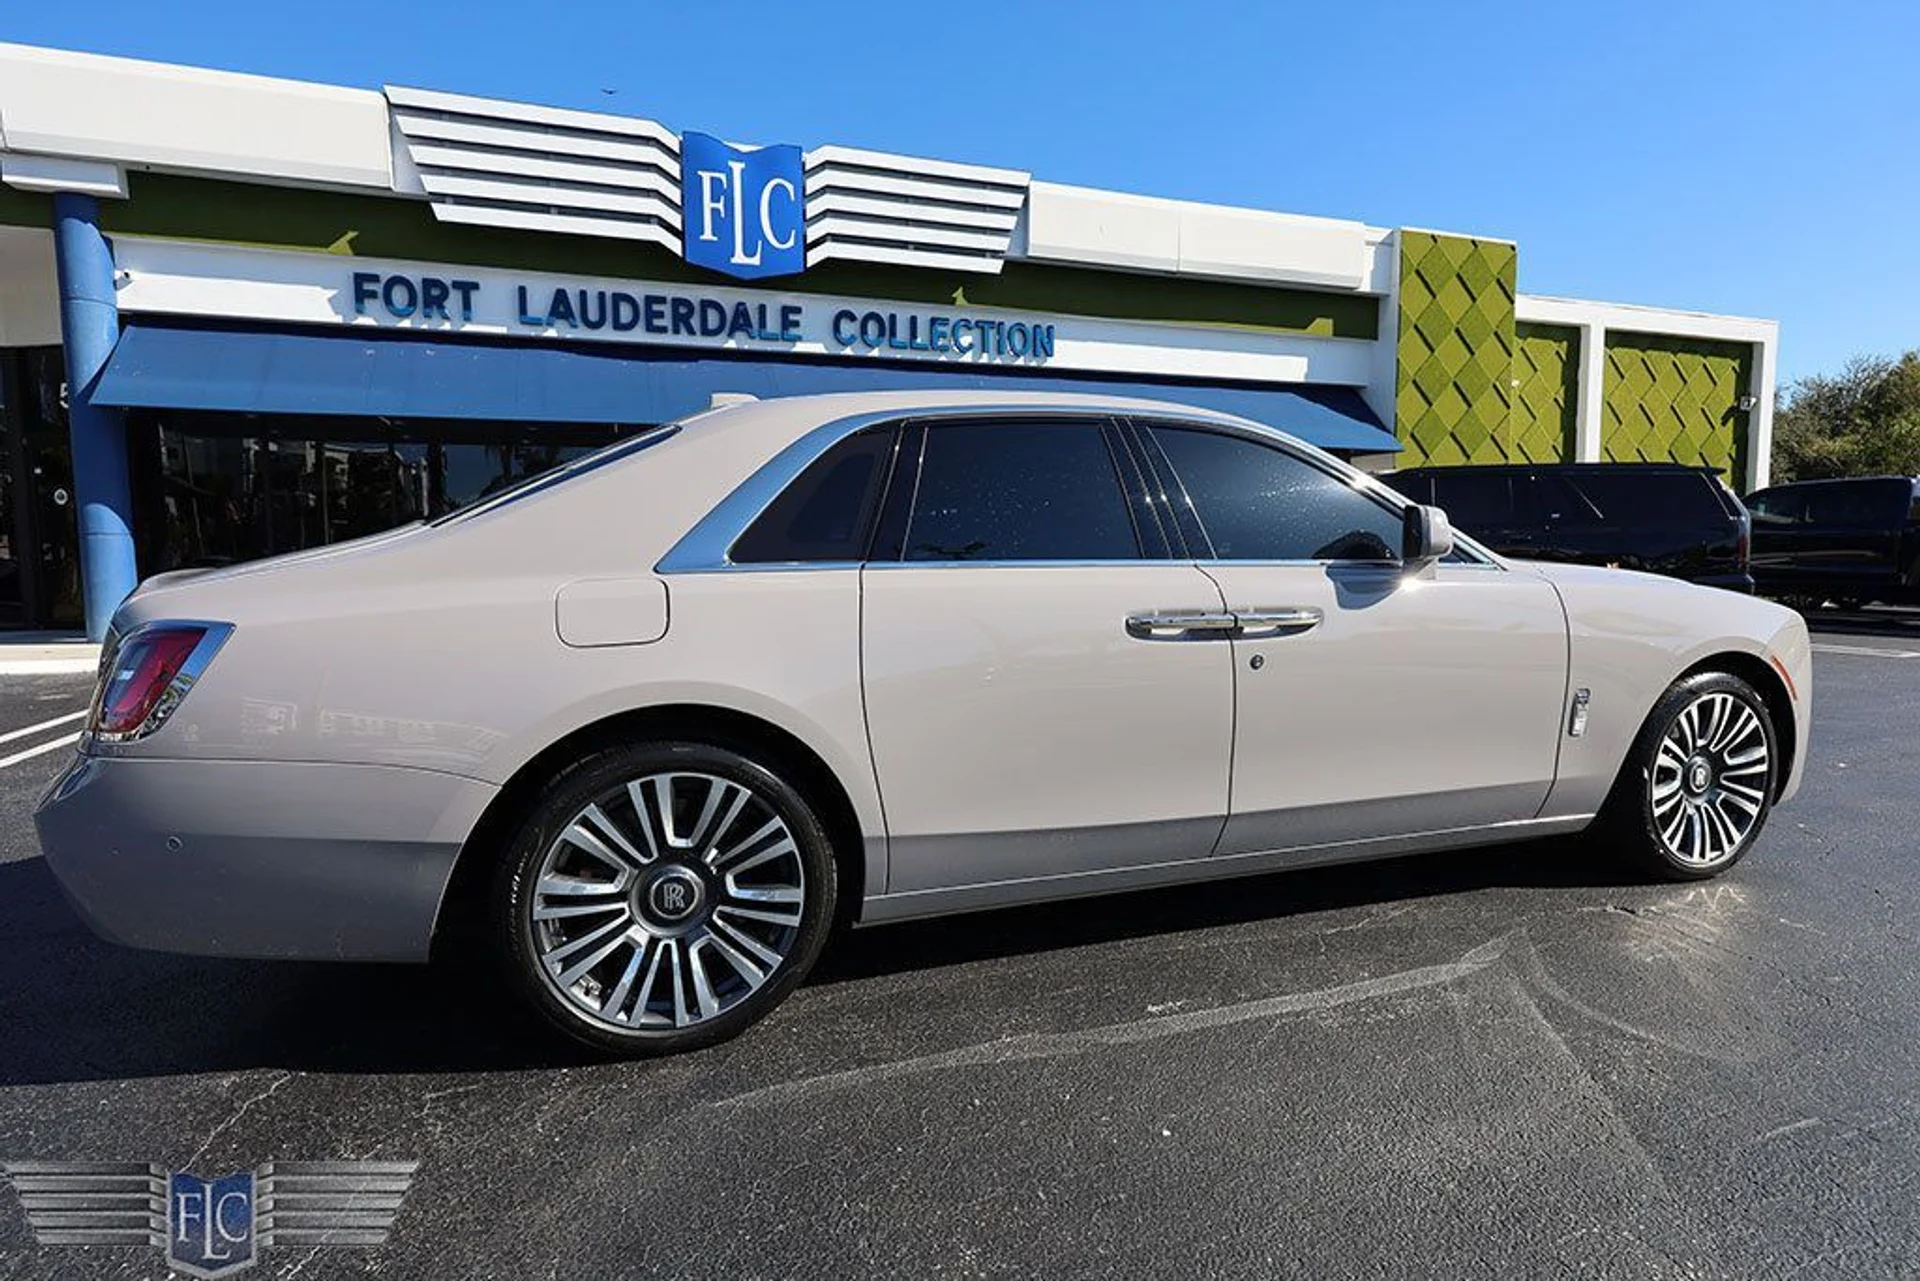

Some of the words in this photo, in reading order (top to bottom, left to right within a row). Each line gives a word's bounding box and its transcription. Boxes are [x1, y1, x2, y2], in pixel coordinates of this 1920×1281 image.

[697, 159, 796, 266] FLC
[352, 271, 481, 322] FORT
[517, 284, 803, 342] LAUDERDALE
[832, 308, 1056, 358] COLLECTION
